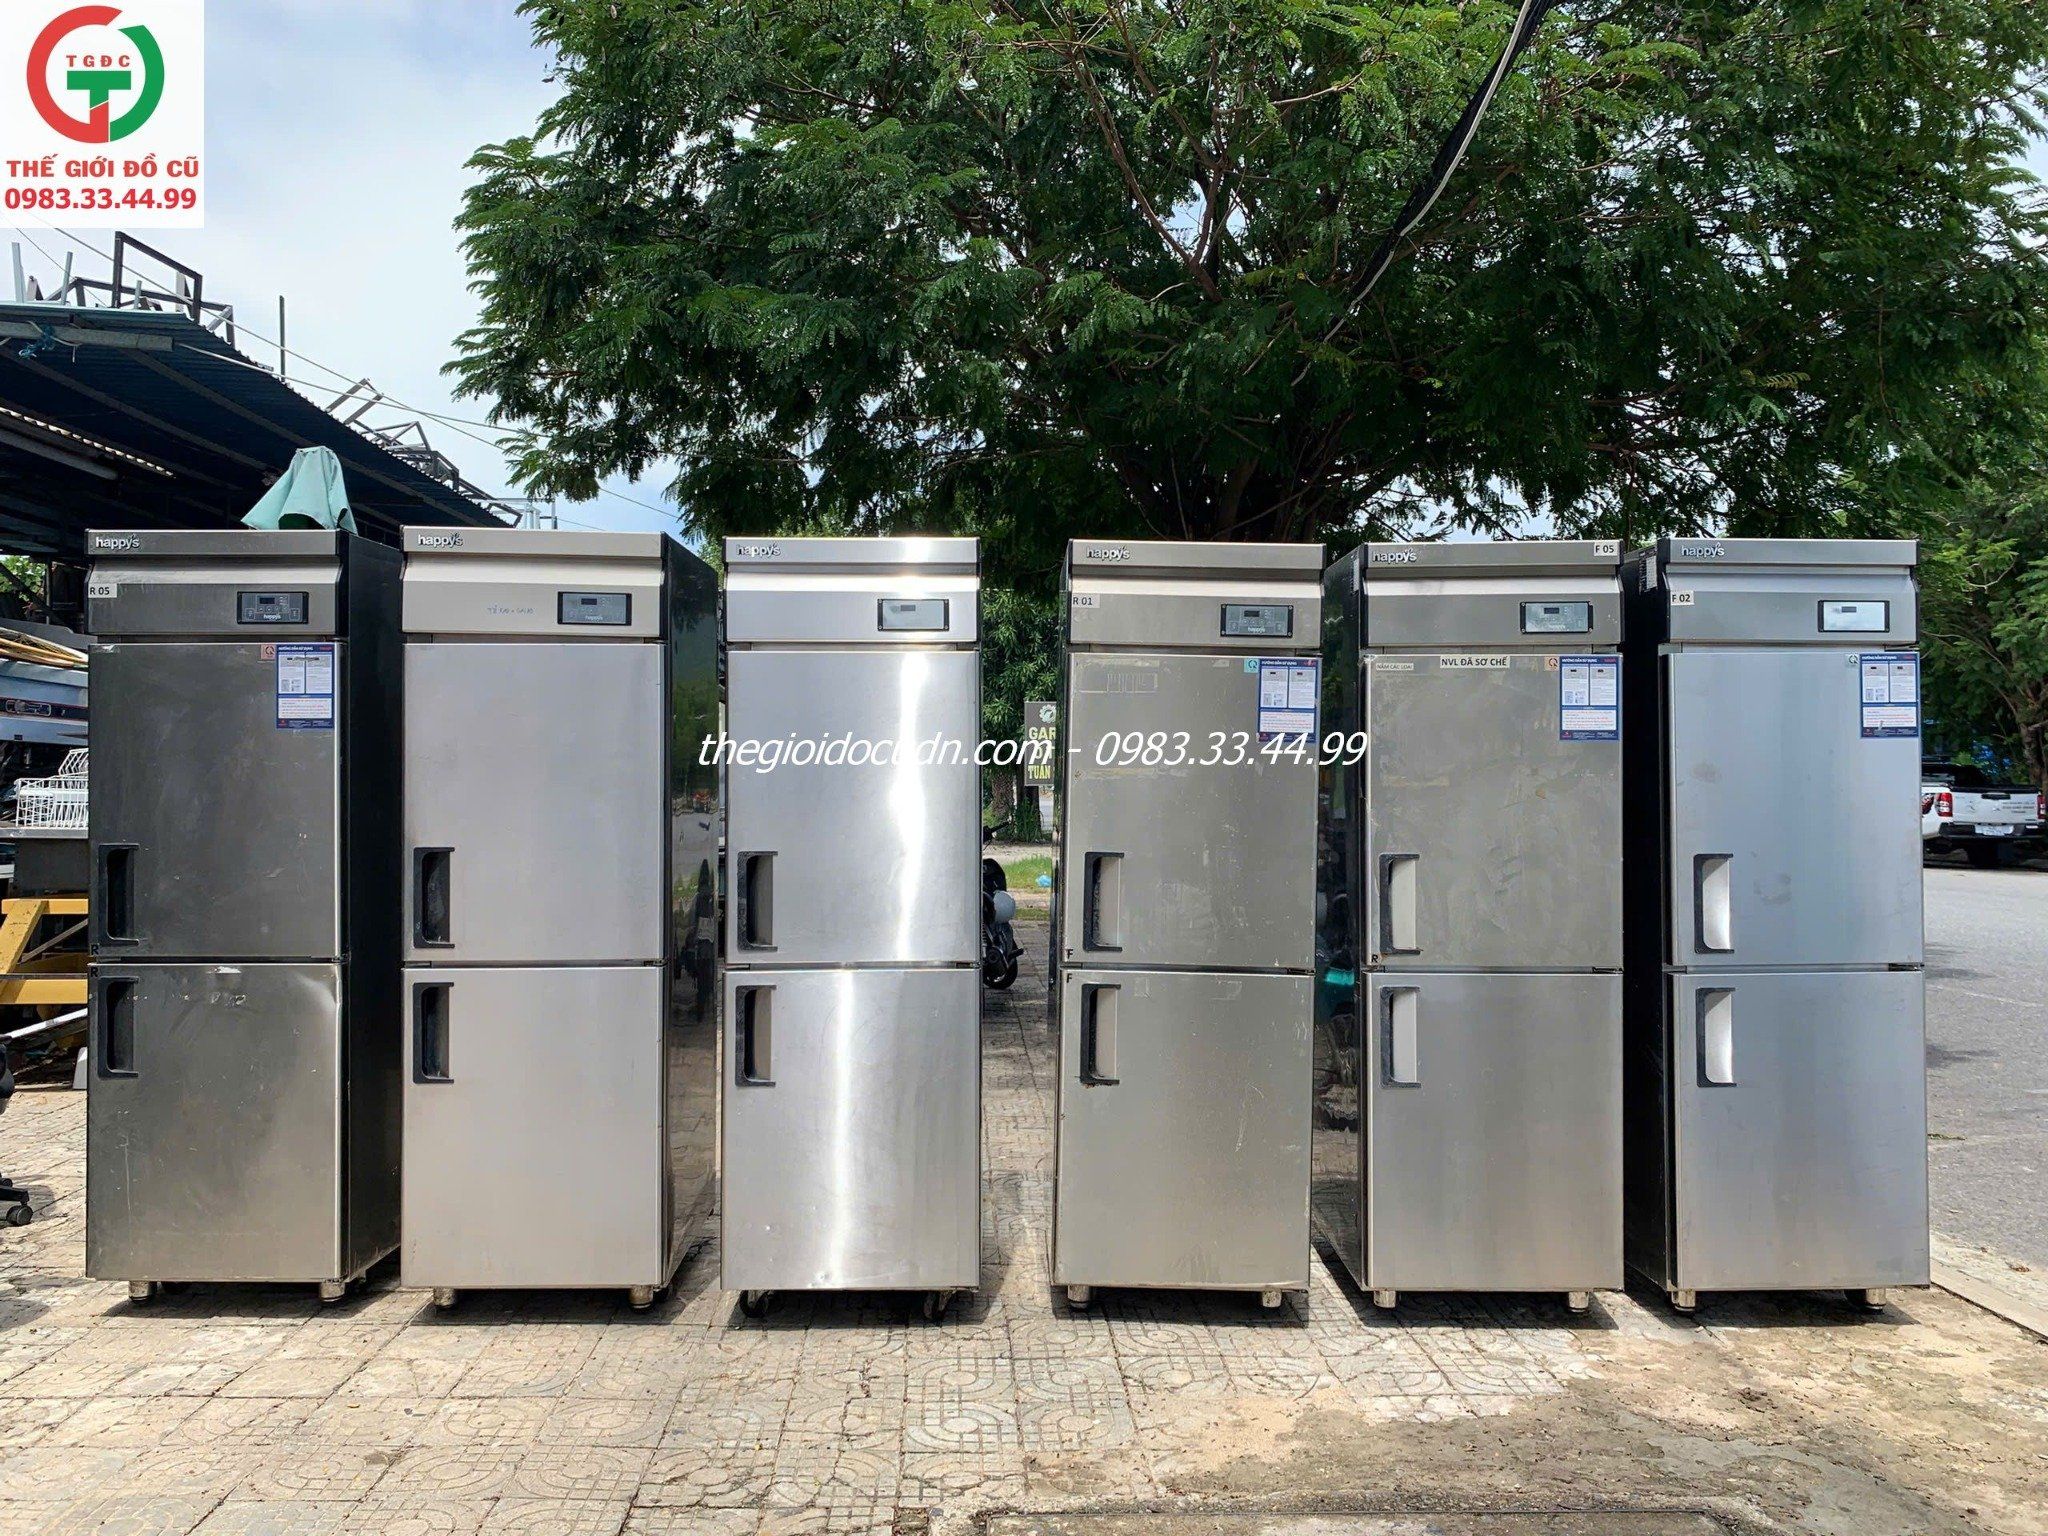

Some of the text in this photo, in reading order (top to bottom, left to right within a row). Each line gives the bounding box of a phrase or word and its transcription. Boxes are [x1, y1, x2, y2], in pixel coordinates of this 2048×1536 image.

[1595, 545, 1614, 553] F 05
[89, 587, 110, 595] R 05
[1073, 597, 1093, 606] R 01
[1672, 594, 1691, 602] F 02
[1441, 655, 1508, 666] NVL ĐÃ SƠ CHẾ
[91, 944, 99, 955] R
[1067, 949, 1074, 959] F
[1371, 954, 1378, 963] R
[91, 967, 98, 977] R
[1066, 973, 1073, 983] F
